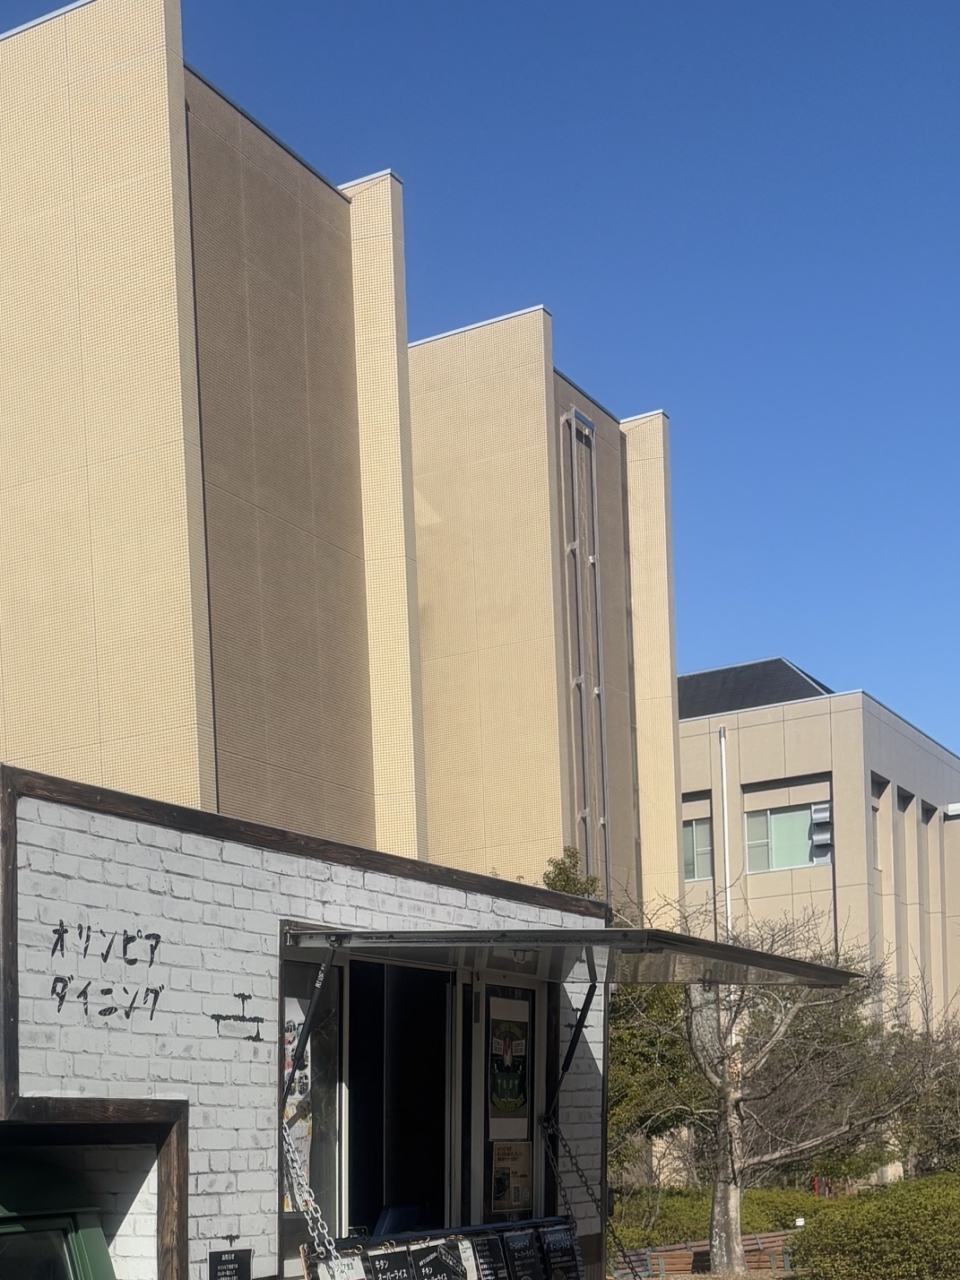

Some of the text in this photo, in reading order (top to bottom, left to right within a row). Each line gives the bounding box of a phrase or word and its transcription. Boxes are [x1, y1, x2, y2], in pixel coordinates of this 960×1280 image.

[51, 919, 162, 968] オリンピア
[51, 974, 165, 1021] ダイニング
